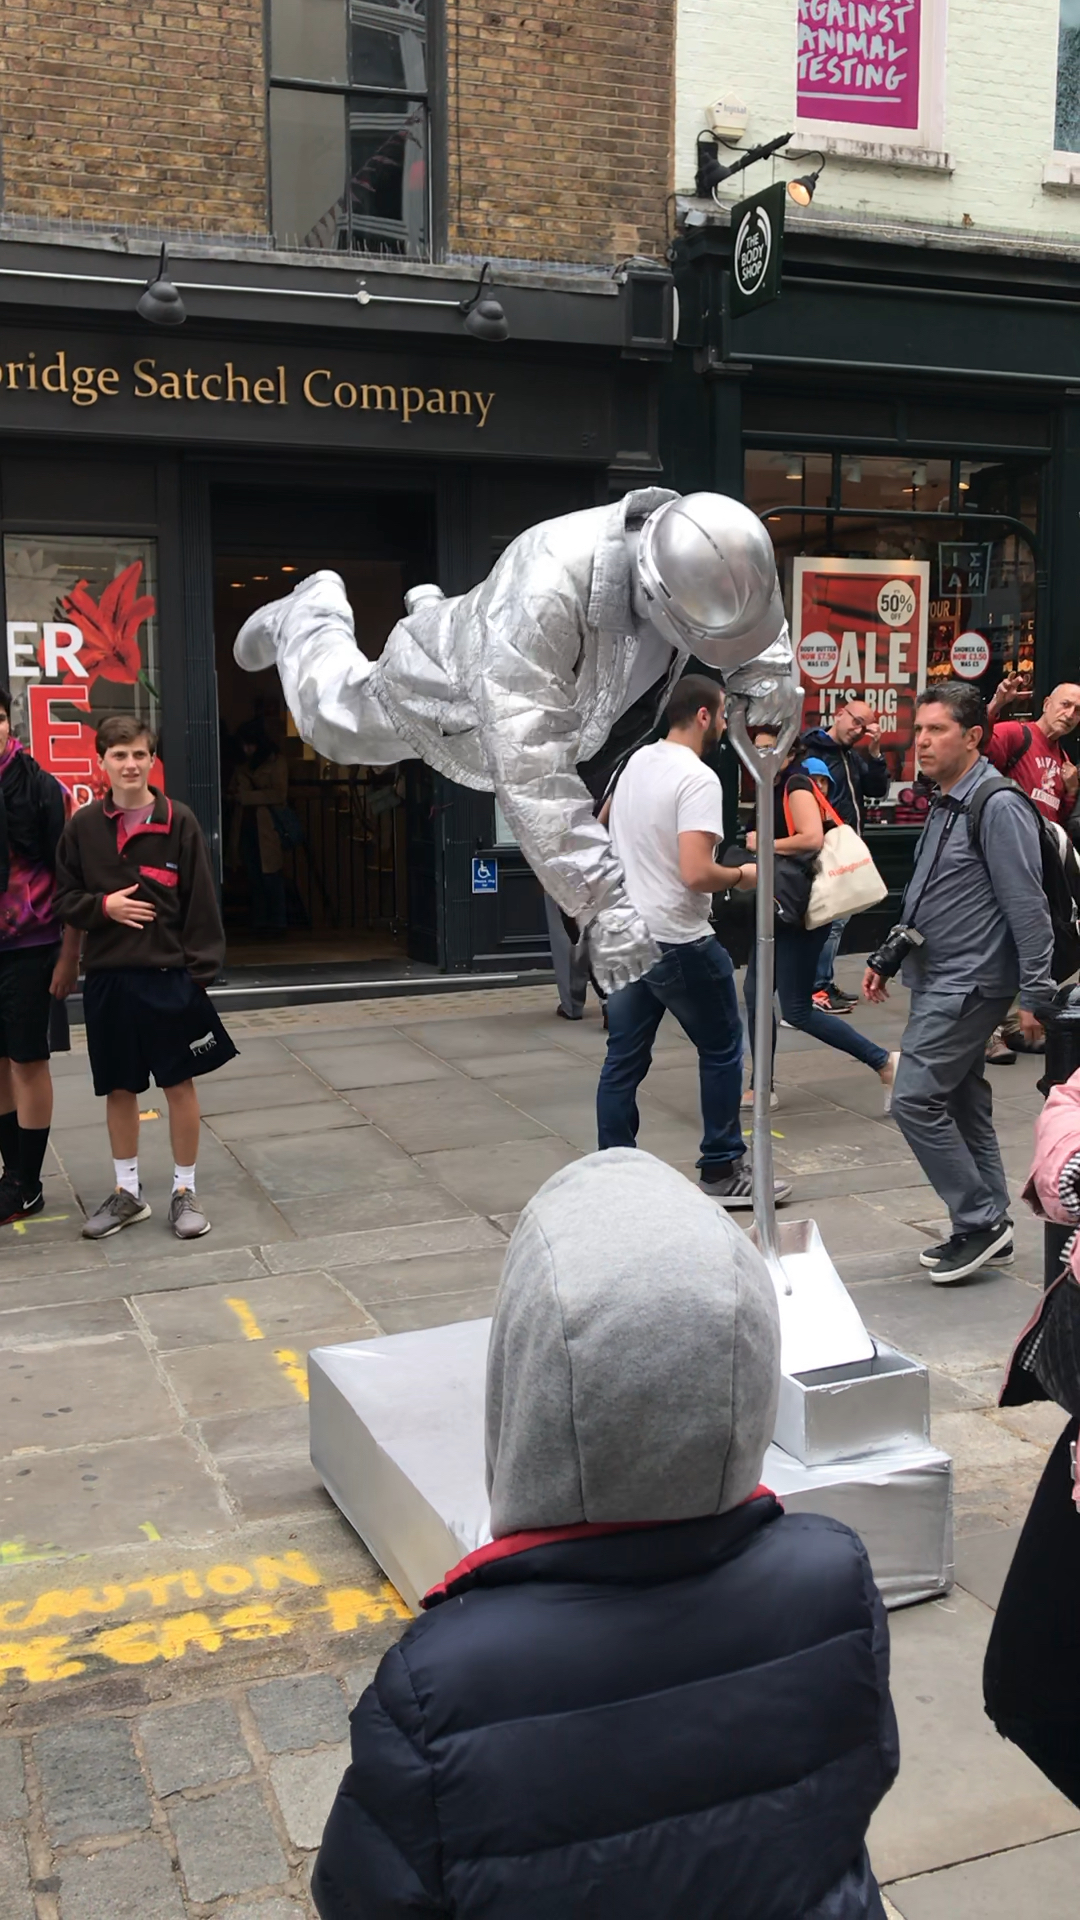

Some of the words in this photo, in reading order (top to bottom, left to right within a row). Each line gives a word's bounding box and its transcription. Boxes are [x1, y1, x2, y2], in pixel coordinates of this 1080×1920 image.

[797, 22, 908, 62] ANIMAL
[797, 52, 907, 90] TESTING
[746, 232, 759, 249] THE
[741, 243, 764, 267] BODY
[742, 261, 763, 281] SHOP
[0, 351, 119, 406] ridge
[133, 358, 288, 405] Satchel
[303, 369, 495, 427] Company
[881, 594, 912, 613] 50%
[929, 600, 950, 618] OUR
[890, 613, 901, 621] OFF
[809, 631, 911, 684] ALE
[864, 688, 897, 714] BIG
[0, 1550, 322, 1631] CAUTION
